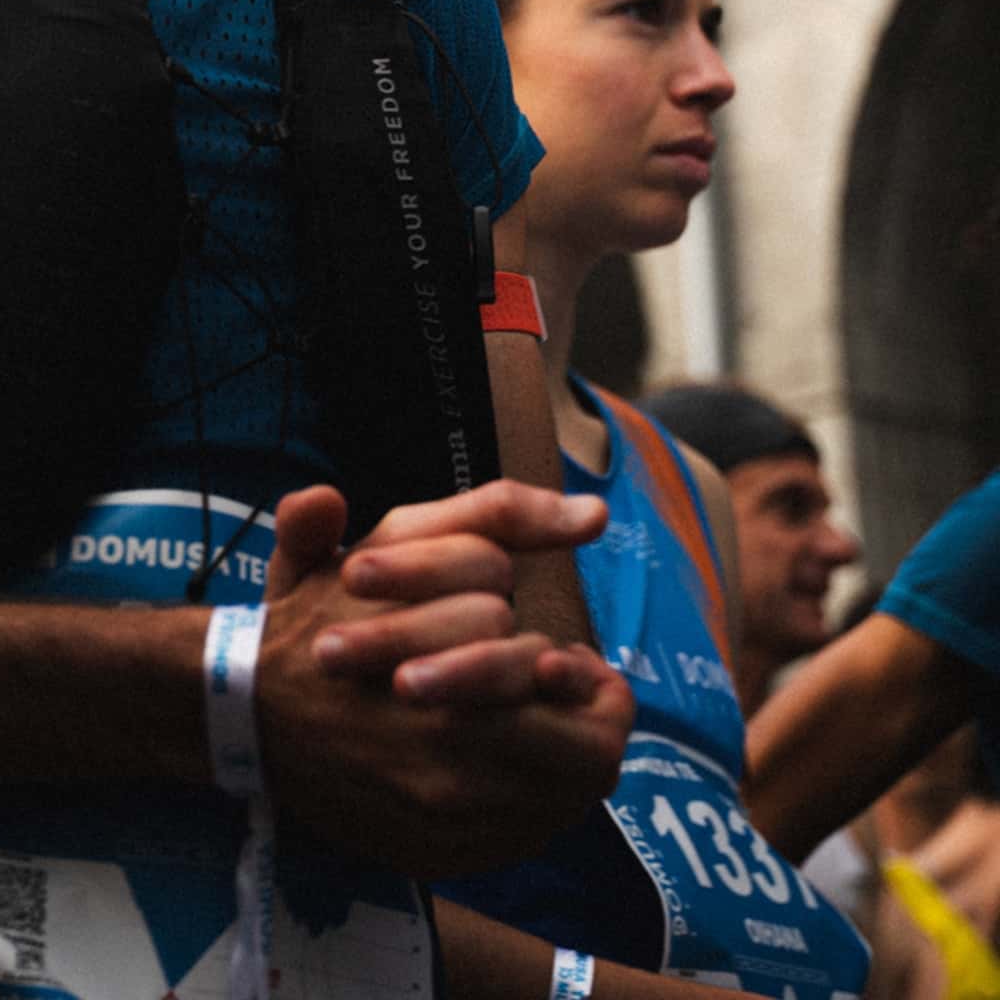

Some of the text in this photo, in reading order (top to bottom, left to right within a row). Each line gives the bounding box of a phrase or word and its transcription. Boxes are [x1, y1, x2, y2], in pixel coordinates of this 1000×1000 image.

[372, 57, 414, 181] FREEDOM
[401, 193, 428, 271] YOUR
[71, 534, 231, 577] DOMUSA
[233, 551, 269, 586] TE
